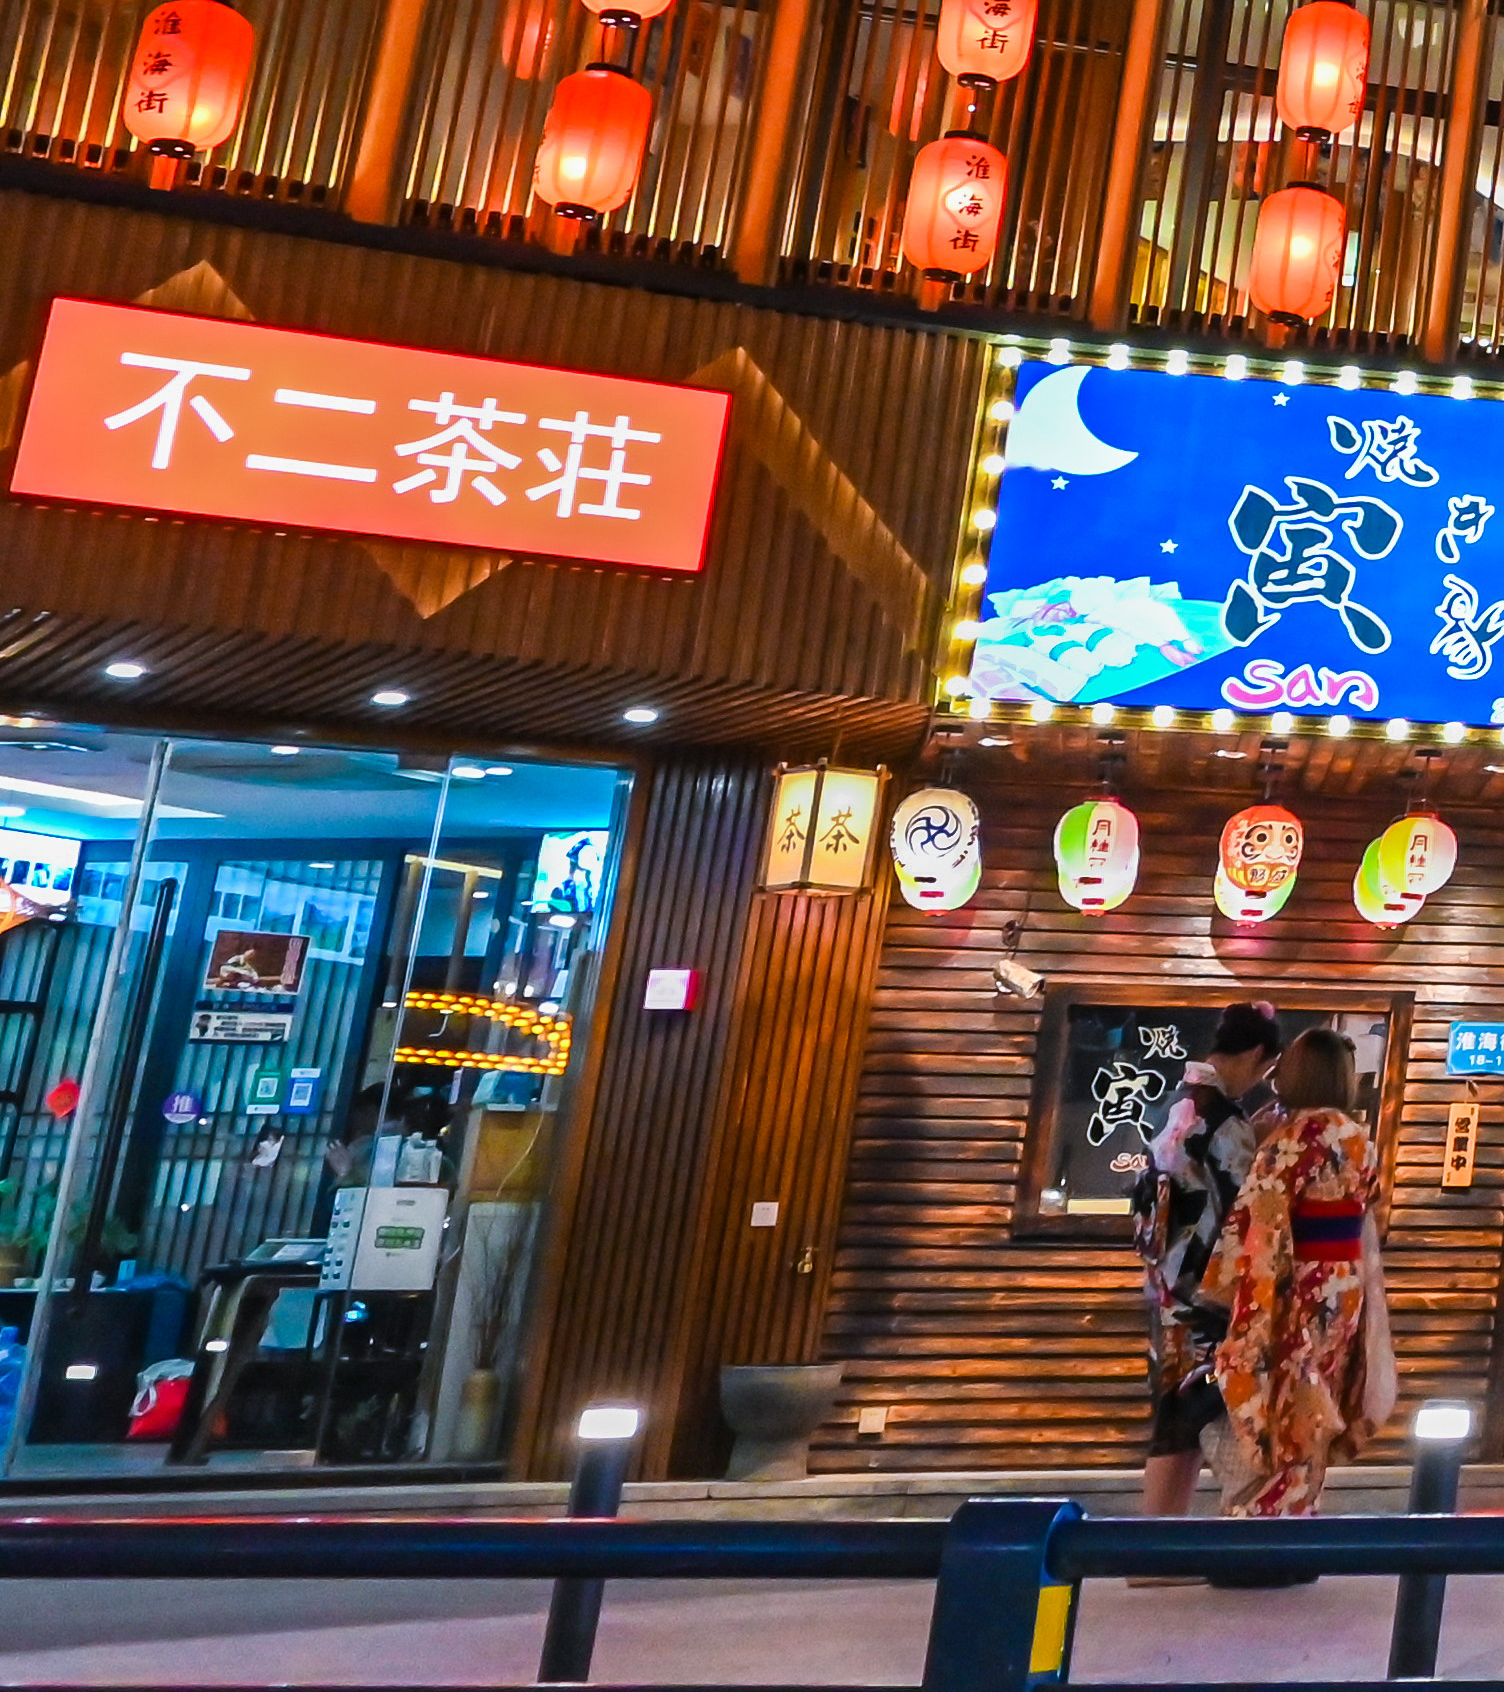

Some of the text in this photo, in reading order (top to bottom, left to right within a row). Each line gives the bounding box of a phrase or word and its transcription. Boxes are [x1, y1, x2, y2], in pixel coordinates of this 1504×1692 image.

[134, 11, 182, 114] 淮海街
[948, 156, 991, 253] 淮海街
[105, 351, 661, 520] 不二茶荘
[777, 804, 805, 854] 茶
[818, 806, 860, 855] 茶
[1469, 1055, 1502, 1066] 18-1
